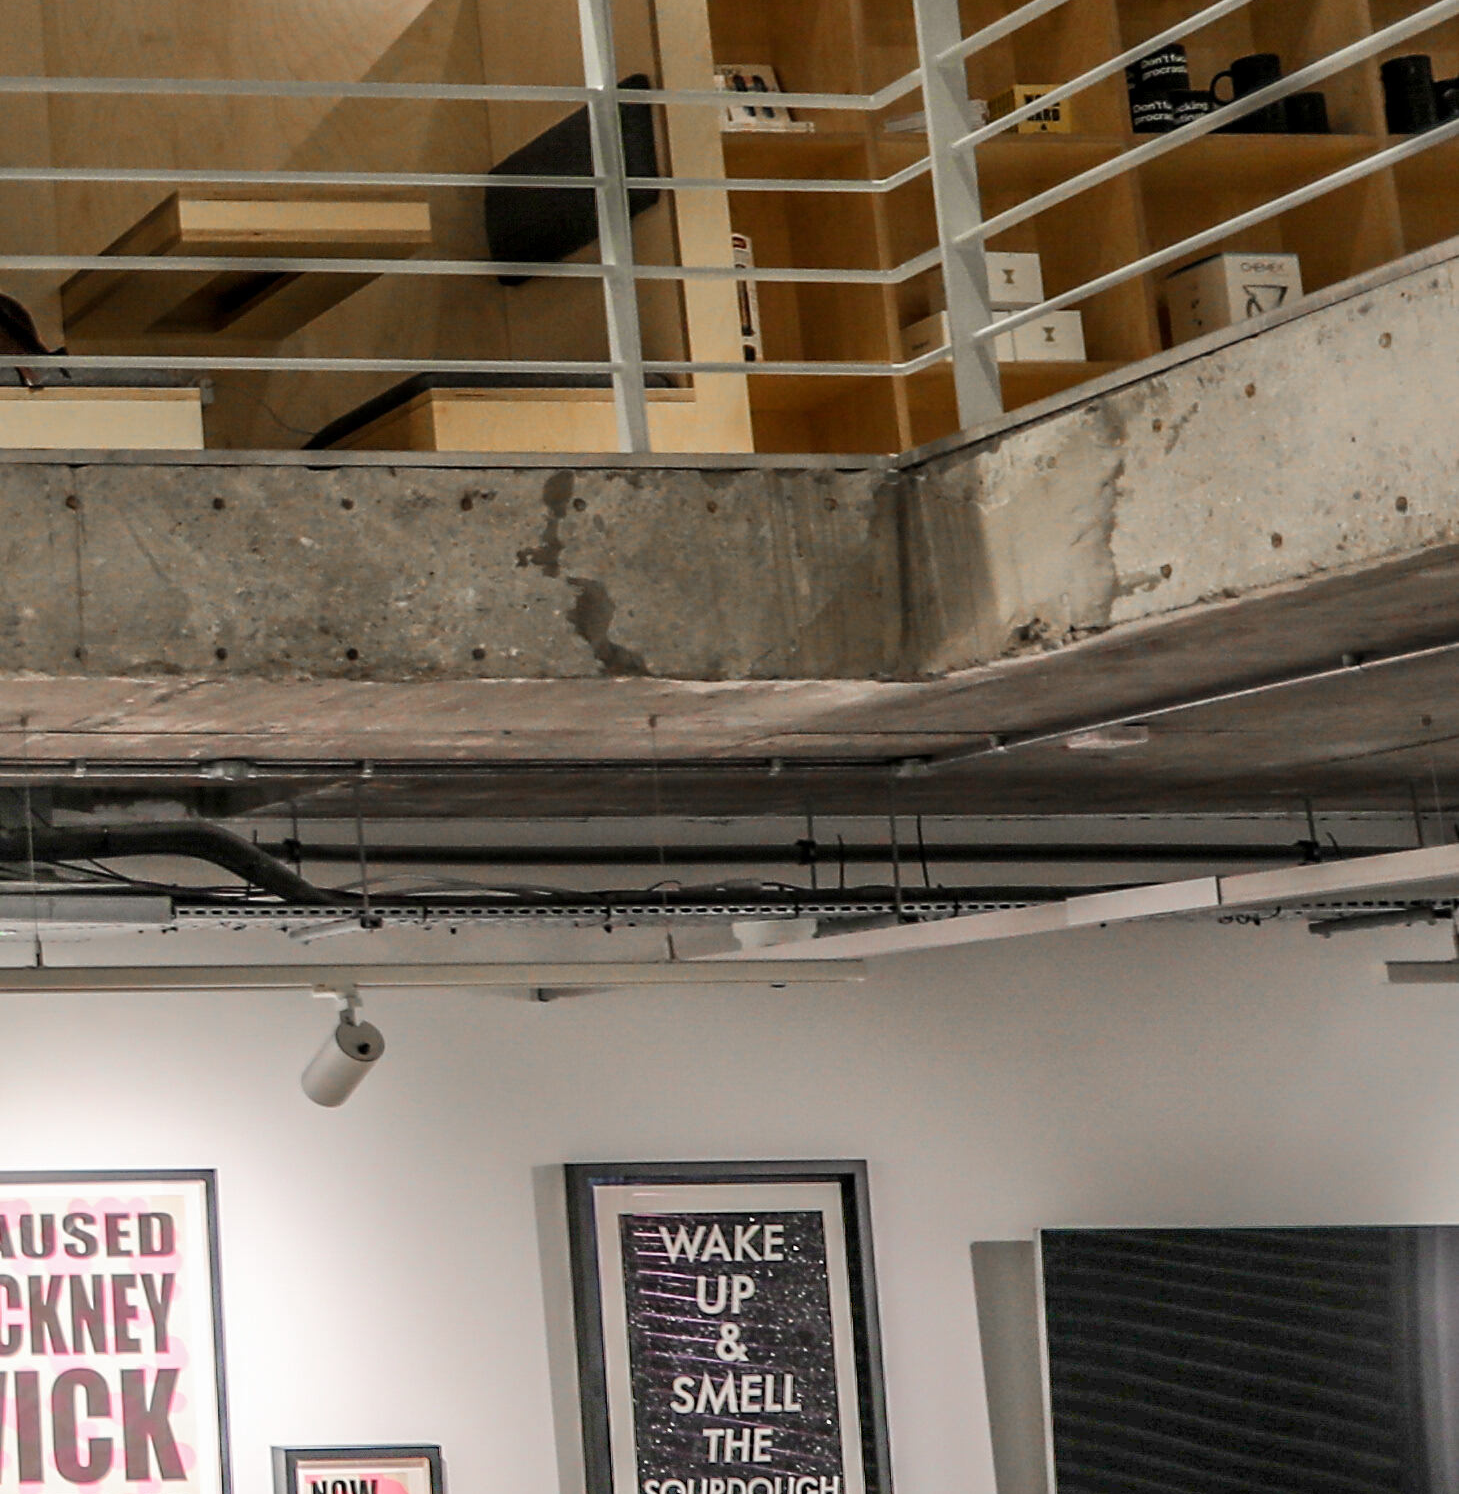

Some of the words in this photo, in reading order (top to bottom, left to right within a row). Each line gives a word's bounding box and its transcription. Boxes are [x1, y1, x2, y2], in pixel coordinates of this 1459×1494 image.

[658, 1224, 785, 1264] WAKE
[695, 1275, 756, 1315] UP
[715, 1322, 749, 1363] &
[670, 1370, 802, 1415] SMELL
[703, 1427, 773, 1465] THE
